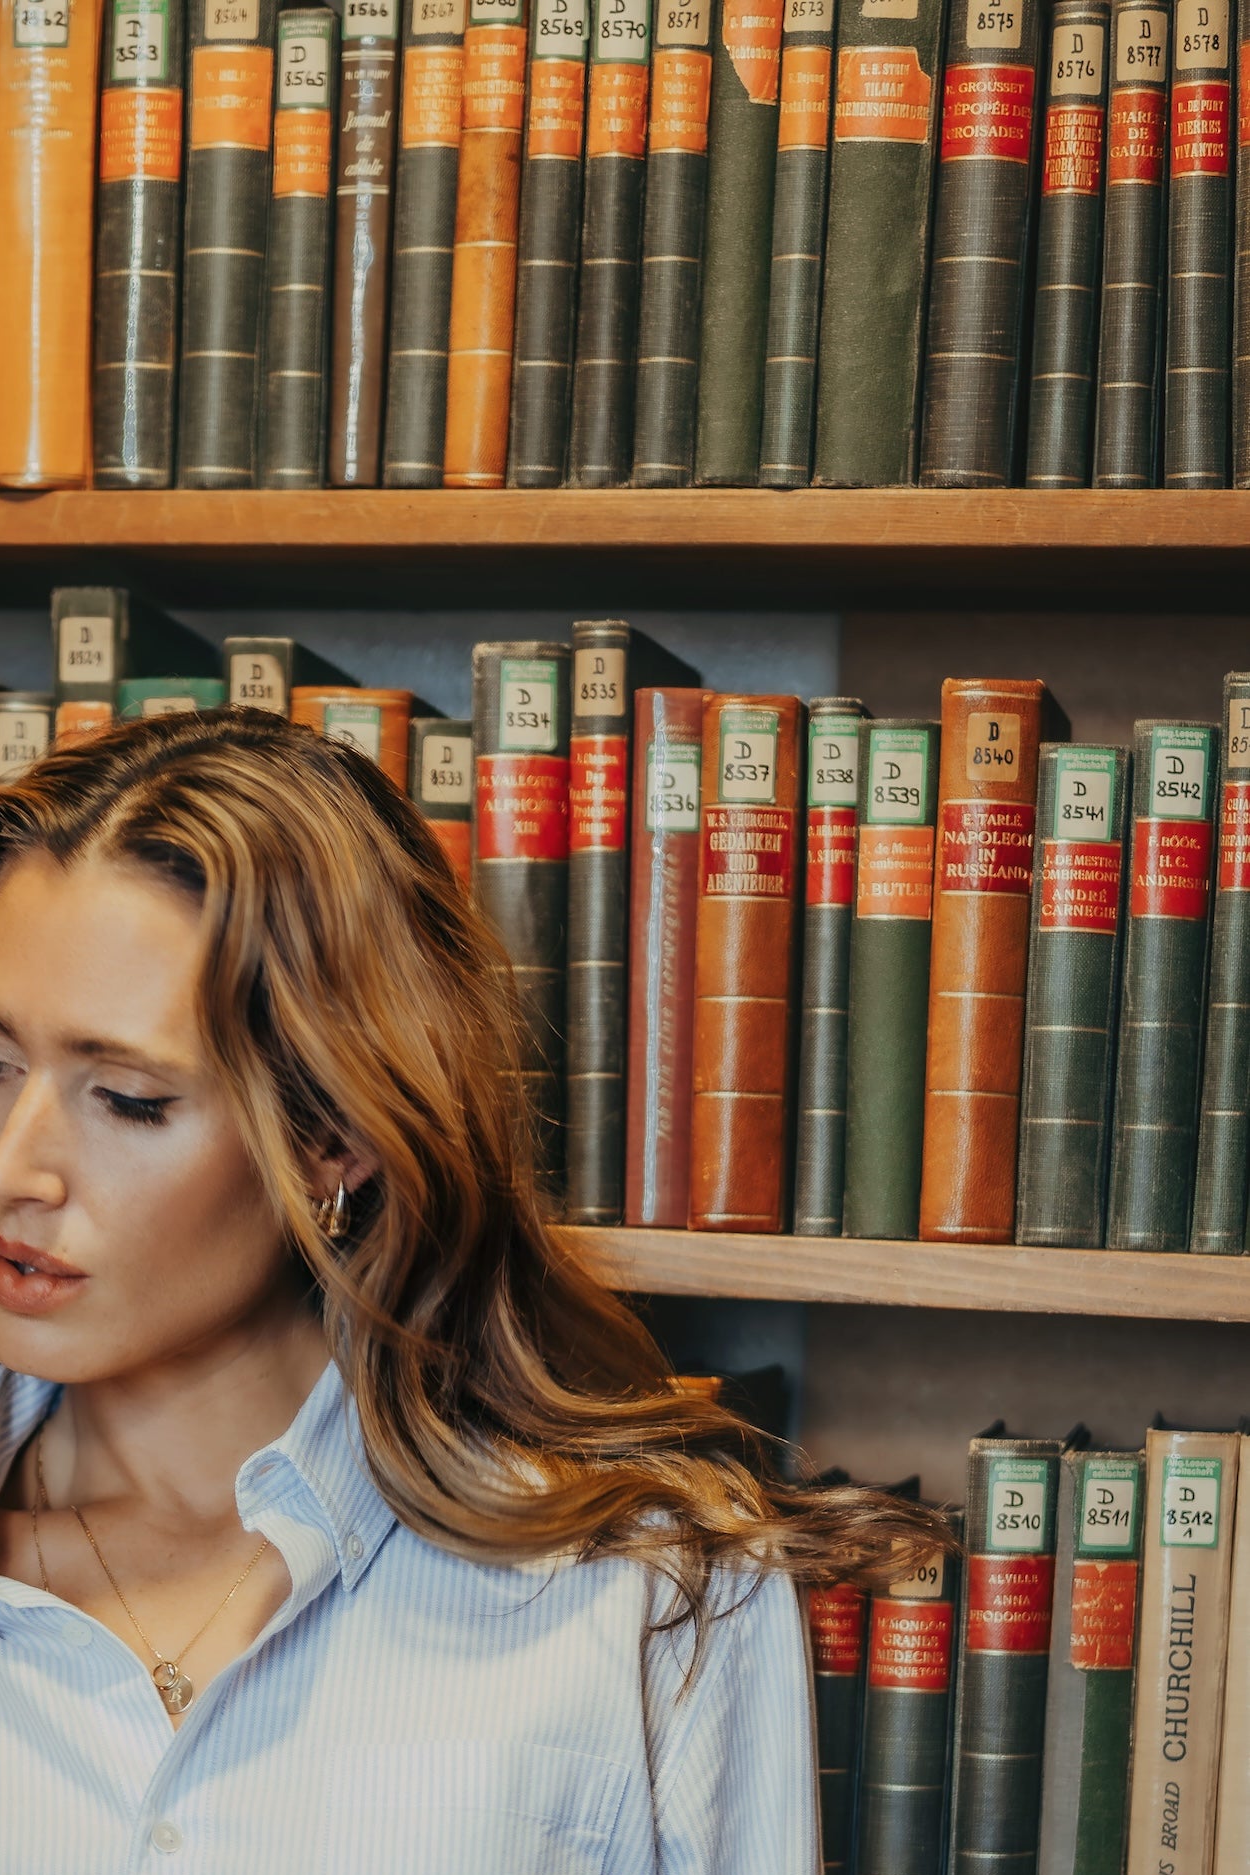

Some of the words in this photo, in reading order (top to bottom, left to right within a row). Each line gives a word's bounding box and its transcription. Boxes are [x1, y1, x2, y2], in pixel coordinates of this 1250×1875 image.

[551, 0, 568, 13] D
[609, 0, 625, 13] D
[791, 3, 826, 18] 8573
[668, 12, 700, 29] 8571
[977, 12, 1014, 33] 8575
[1197, 8, 1209, 26] D
[540, 19, 583, 37] 8569
[601, 20, 647, 39] 8570
[1139, 20, 1151, 39] D
[1071, 33, 1084, 54] D
[1184, 35, 1220, 53] 8578
[290, 46, 307, 63] D
[1127, 46, 1162, 67] 8577
[1057, 60, 1095, 79] 8576
[958, 81, 1024, 95] GROUSSET
[1111, 111, 1163, 125] CHARL
[946, 124, 1024, 140] CROISADES
[1128, 127, 1149, 140] DE
[1177, 120, 1222, 136] PIERRES
[1110, 144, 1164, 158] GAULLE
[1175, 143, 1224, 160] VIVANTES
[80, 627, 93, 643] D
[252, 664, 265, 680] D
[593, 657, 606, 675] D
[517, 689, 532, 705] D
[580, 682, 618, 700] 8535
[506, 711, 551, 728] 8534
[987, 721, 999, 741] D
[442, 745, 454, 763] D
[734, 741, 752, 760] D
[823, 743, 841, 760] D
[972, 747, 1014, 765] 8540
[881, 762, 900, 780] D
[1165, 756, 1184, 774] D
[724, 765, 770, 783] 8537
[815, 768, 854, 784] 8538
[874, 786, 920, 807] 8539
[1072, 781, 1087, 797] D
[1156, 779, 1202, 800] 8542
[962, 813, 974, 826] E.
[1061, 804, 1104, 821] 8541
[710, 831, 782, 851] GEDANKEN
[943, 830, 1033, 848] NAPOLEON
[727, 853, 758, 872] UND
[978, 848, 996, 864] IN
[1055, 854, 1072, 868] DE
[1074, 855, 1120, 870] MESTRA
[1159, 855, 1173, 868] H.
[1175, 855, 1189, 869] C.
[706, 873, 784, 894] ABENTEUER
[1042, 870, 1121, 885] OMBREMONT
[1051, 886, 1108, 903] ANDRÉ
[1041, 903, 1117, 920] CARNEGIE
[1003, 1489, 1024, 1507] D
[1096, 1488, 1114, 1505] D
[1179, 1487, 1196, 1502] D
[996, 1513, 1041, 1530] 8510
[1086, 1508, 1131, 1528] 8511
[1166, 1509, 1214, 1526] 8512
[1183, 1527, 1193, 1539] 1
[988, 1572, 1039, 1586] ALVILLE
[992, 1593, 1031, 1607] ANNA
[881, 1634, 939, 1649] GRANDS
[1162, 1573, 1197, 1762] CHURCHILL
[1163, 1781, 1182, 1851] BROAD
